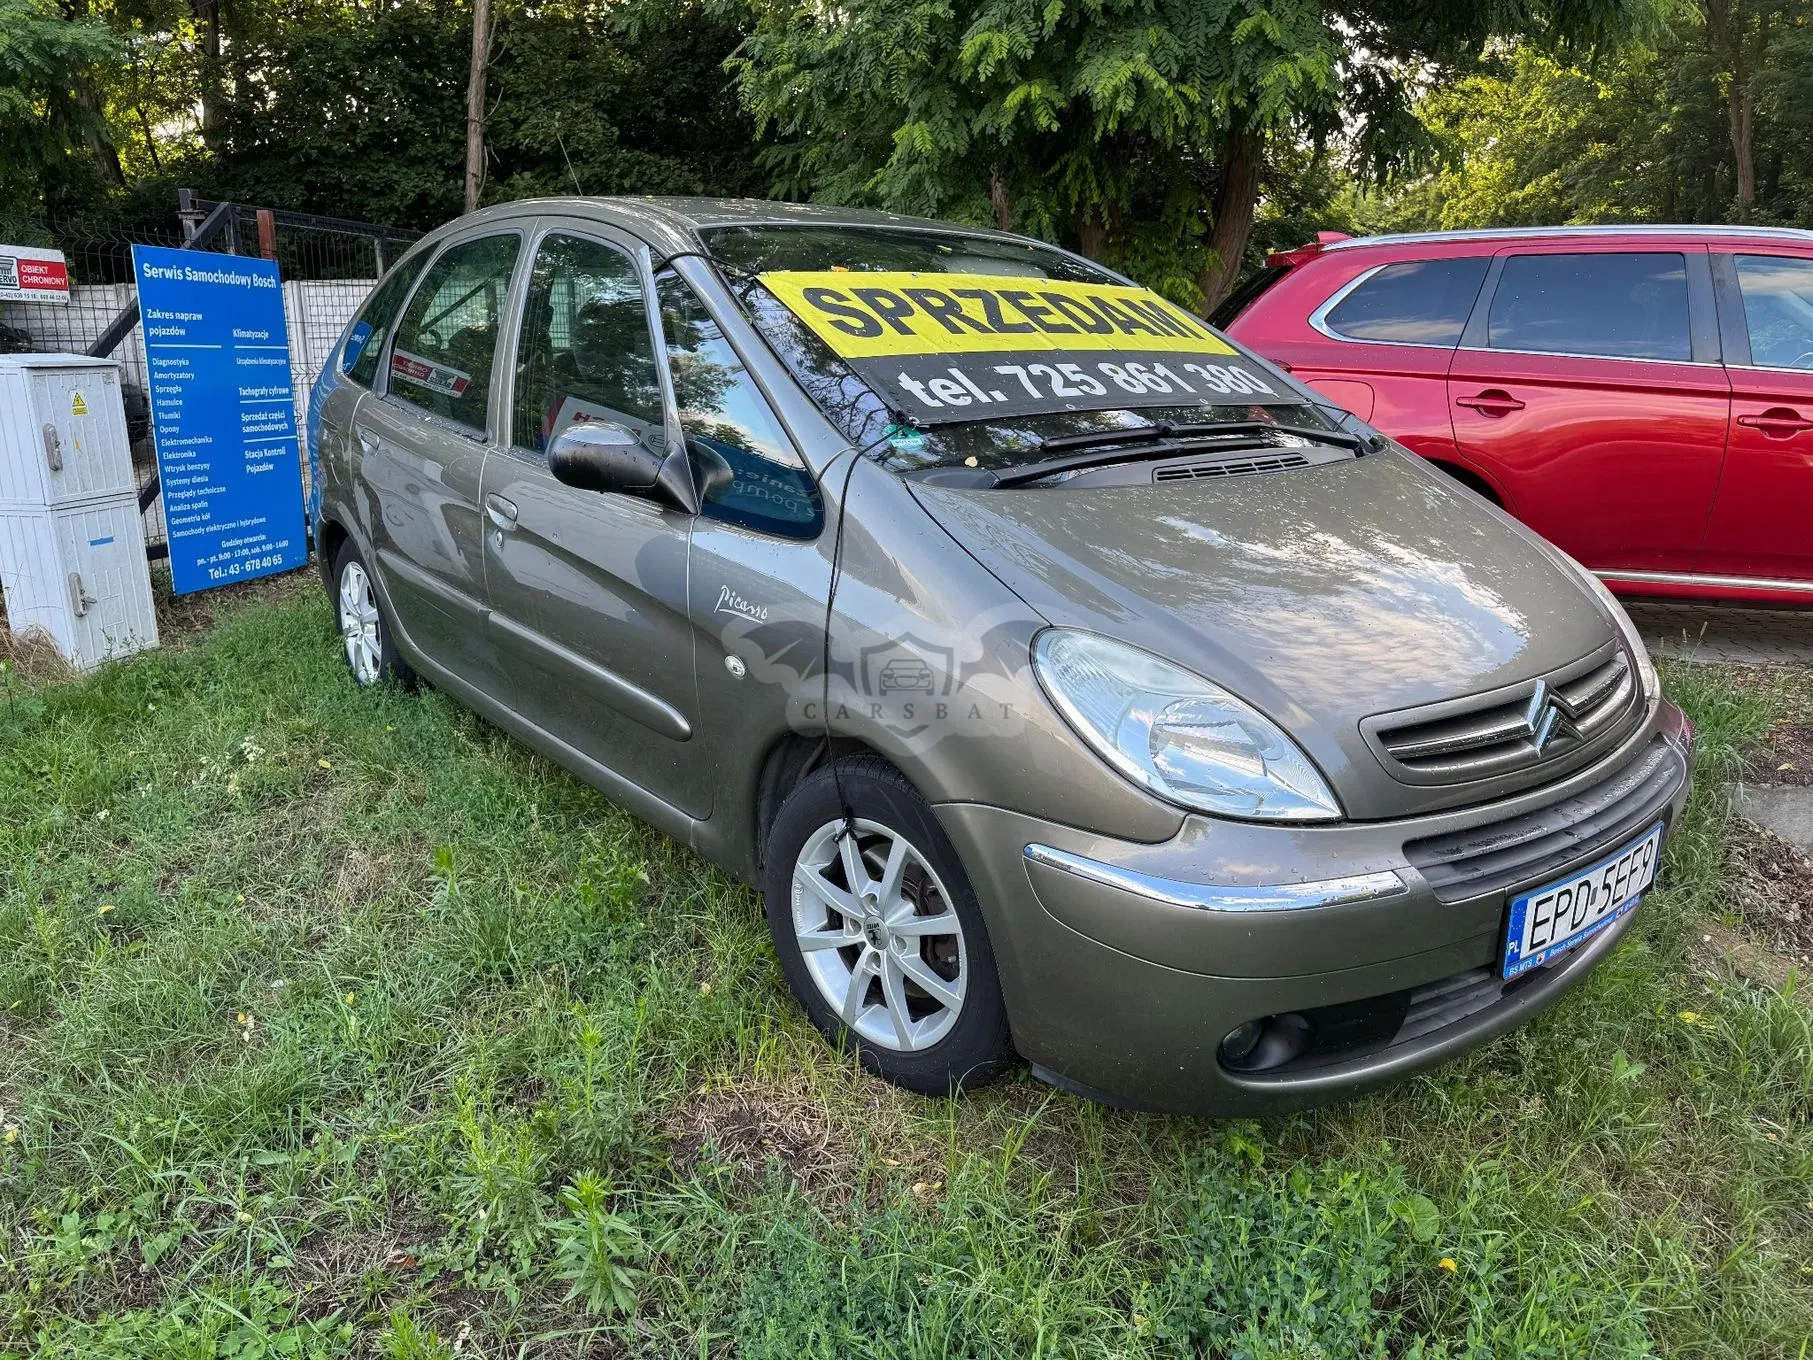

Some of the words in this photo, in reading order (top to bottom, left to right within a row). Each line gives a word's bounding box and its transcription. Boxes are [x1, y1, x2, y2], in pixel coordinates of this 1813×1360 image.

[21, 264, 49, 274] OBIEKT
[22, 275, 65, 286] CHRONIONY
[143, 262, 184, 280] Serwis
[184, 266, 252, 289] Samochodowy
[252, 274, 277, 289] Bosch
[146, 308, 174, 320] Zakres
[175, 311, 203, 322] napraw
[802, 288, 1206, 340] SPRZEDAM
[149, 326, 186, 337] pojazdów
[232, 328, 269, 340] Klimatyzacje
[152, 357, 190, 367] Diagnostyka
[154, 371, 195, 380] Amortyzatory
[155, 385, 182, 394] Sprzęgła
[898, 367, 1009, 407] tel.
[993, 363, 1107, 399] 725
[1097, 362, 1197, 394] 861
[1183, 363, 1275, 395] 380
[238, 386, 269, 397] Tachografy
[268, 385, 290, 396] cyfrowe
[156, 398, 183, 406] Hamulce
[158, 411, 181, 420] Tłumiki
[241, 411, 268, 423] Sprzedaż
[268, 410, 286, 421] części
[159, 425, 180, 434] Opony
[242, 421, 288, 433] samochodowych
[161, 436, 213, 447] Elektromechanika
[163, 450, 196, 460] Elektronika
[244, 449, 263, 460] Stacja
[263, 446, 286, 457] Kontroli
[164, 464, 186, 473] Wtrysk
[186, 462, 211, 471] benzyny
[246, 462, 274, 474] Pojazdów
[166, 477, 191, 487] Systemy
[191, 475, 209, 484] diesla
[168, 489, 197, 499] Przeglądy
[196, 486, 227, 496] techniczne
[169, 503, 190, 512] Analiza
[191, 500, 209, 510] spalin
[171, 514, 201, 525] Geometria
[201, 512, 211, 520] kół
[172, 526, 205, 538] Samochody
[206, 521, 236, 533] elektryczne
[239, 516, 267, 528] hybrydowe
[221, 537, 243, 548] Godziny
[243, 533, 267, 544] otwarcia:
[218, 551, 231, 561] 9:00
[261, 543, 273, 552] 9:00
[208, 567, 228, 580] Tel.:
[228, 563, 240, 575] 43
[245, 558, 261, 572] 678
[261, 556, 272, 568] 40
[272, 553, 283, 566] 65
[713, 584, 769, 622] Picasso
[1528, 879, 1593, 952] EPD
[1596, 838, 1654, 915] 5EF9
[1507, 940, 1520, 957] PL
